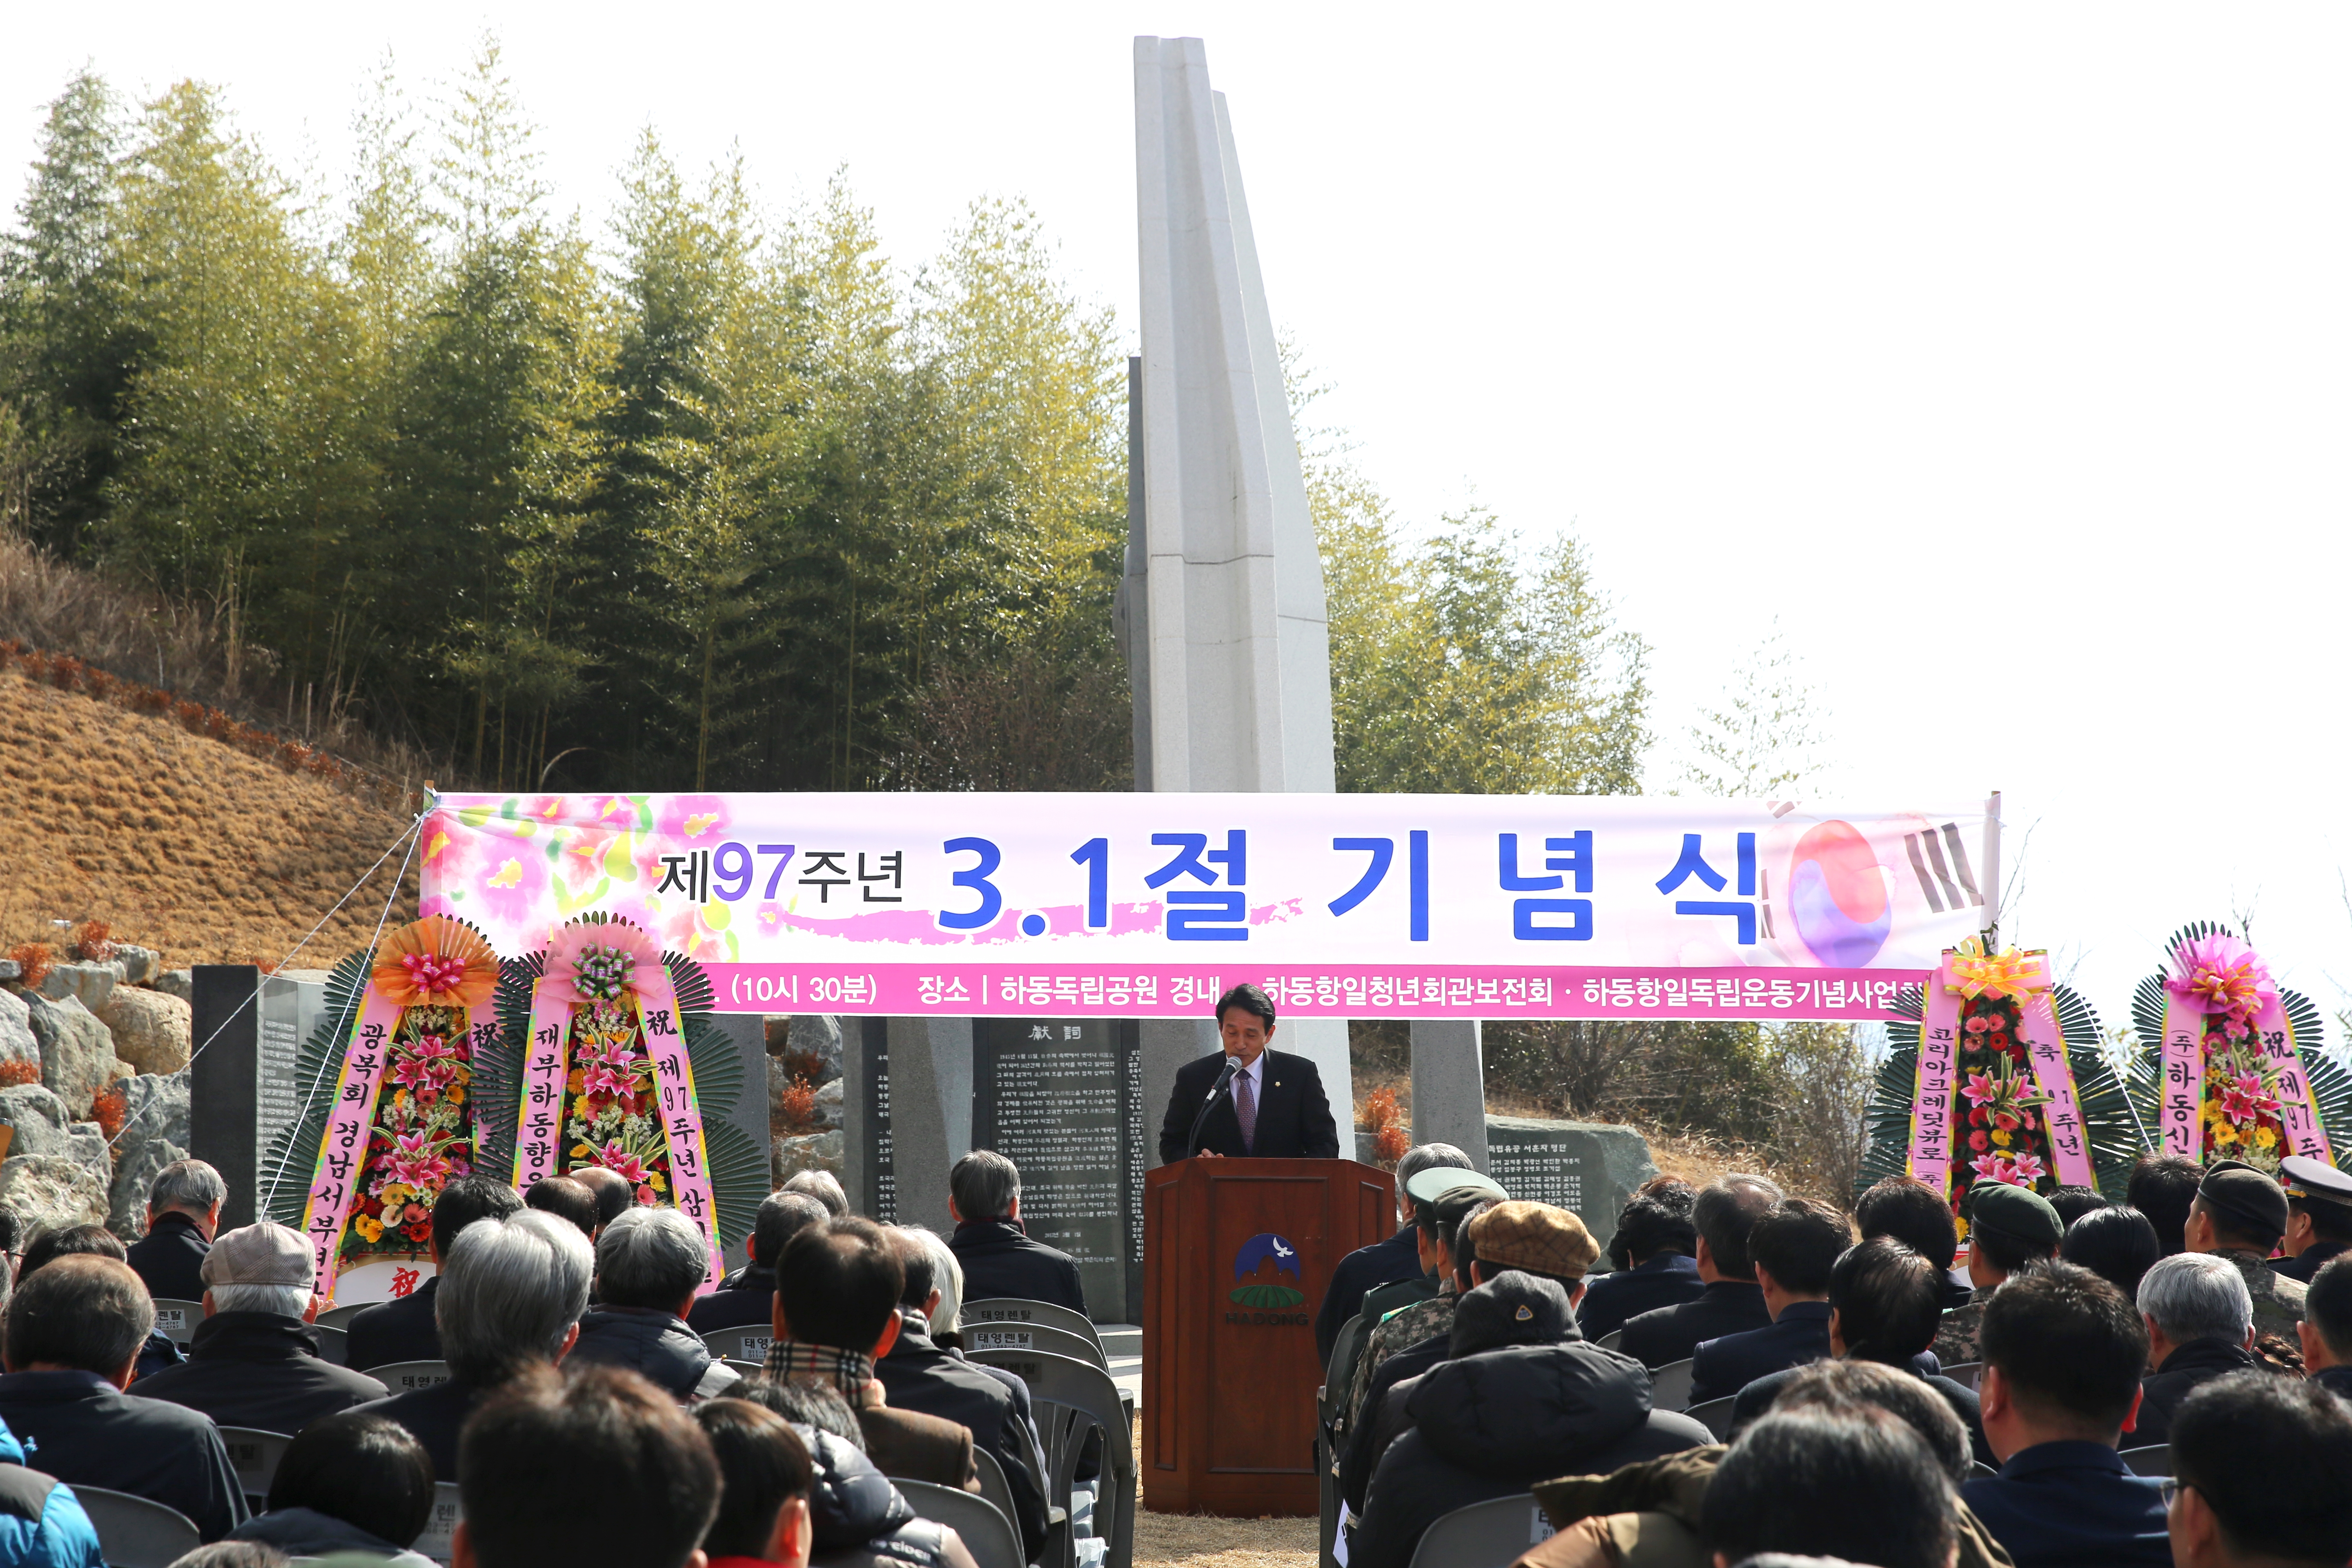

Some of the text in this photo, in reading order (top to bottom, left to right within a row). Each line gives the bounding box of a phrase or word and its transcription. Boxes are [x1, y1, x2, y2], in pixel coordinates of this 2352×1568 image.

[657, 842, 903, 903] 제97주년
[938, 829, 1249, 942] 3.1절
[731, 973, 798, 1004] (10시
[809, 974, 877, 1005] 30분)
[917, 975, 971, 1004] 장소
[1000, 975, 1158, 1005] 하동독립공원
[1169, 976, 1220, 1006] 경내
[1262, 976, 1552, 1007] 하동항일청년회관보전회
[646, 1010, 678, 1036] 祝
[2035, 1044, 2060, 1062] 축
[2263, 1031, 2295, 1058] 祝
[342, 1023, 387, 1110] 광복회
[657, 1054, 697, 1178] 제97주년
[390, 1267, 420, 1298] 祝
[981, 1310, 1031, 1320] 태영렌탈
[1226, 1312, 1309, 1325] HADONG
[978, 1333, 1029, 1344] 태영렌탈
